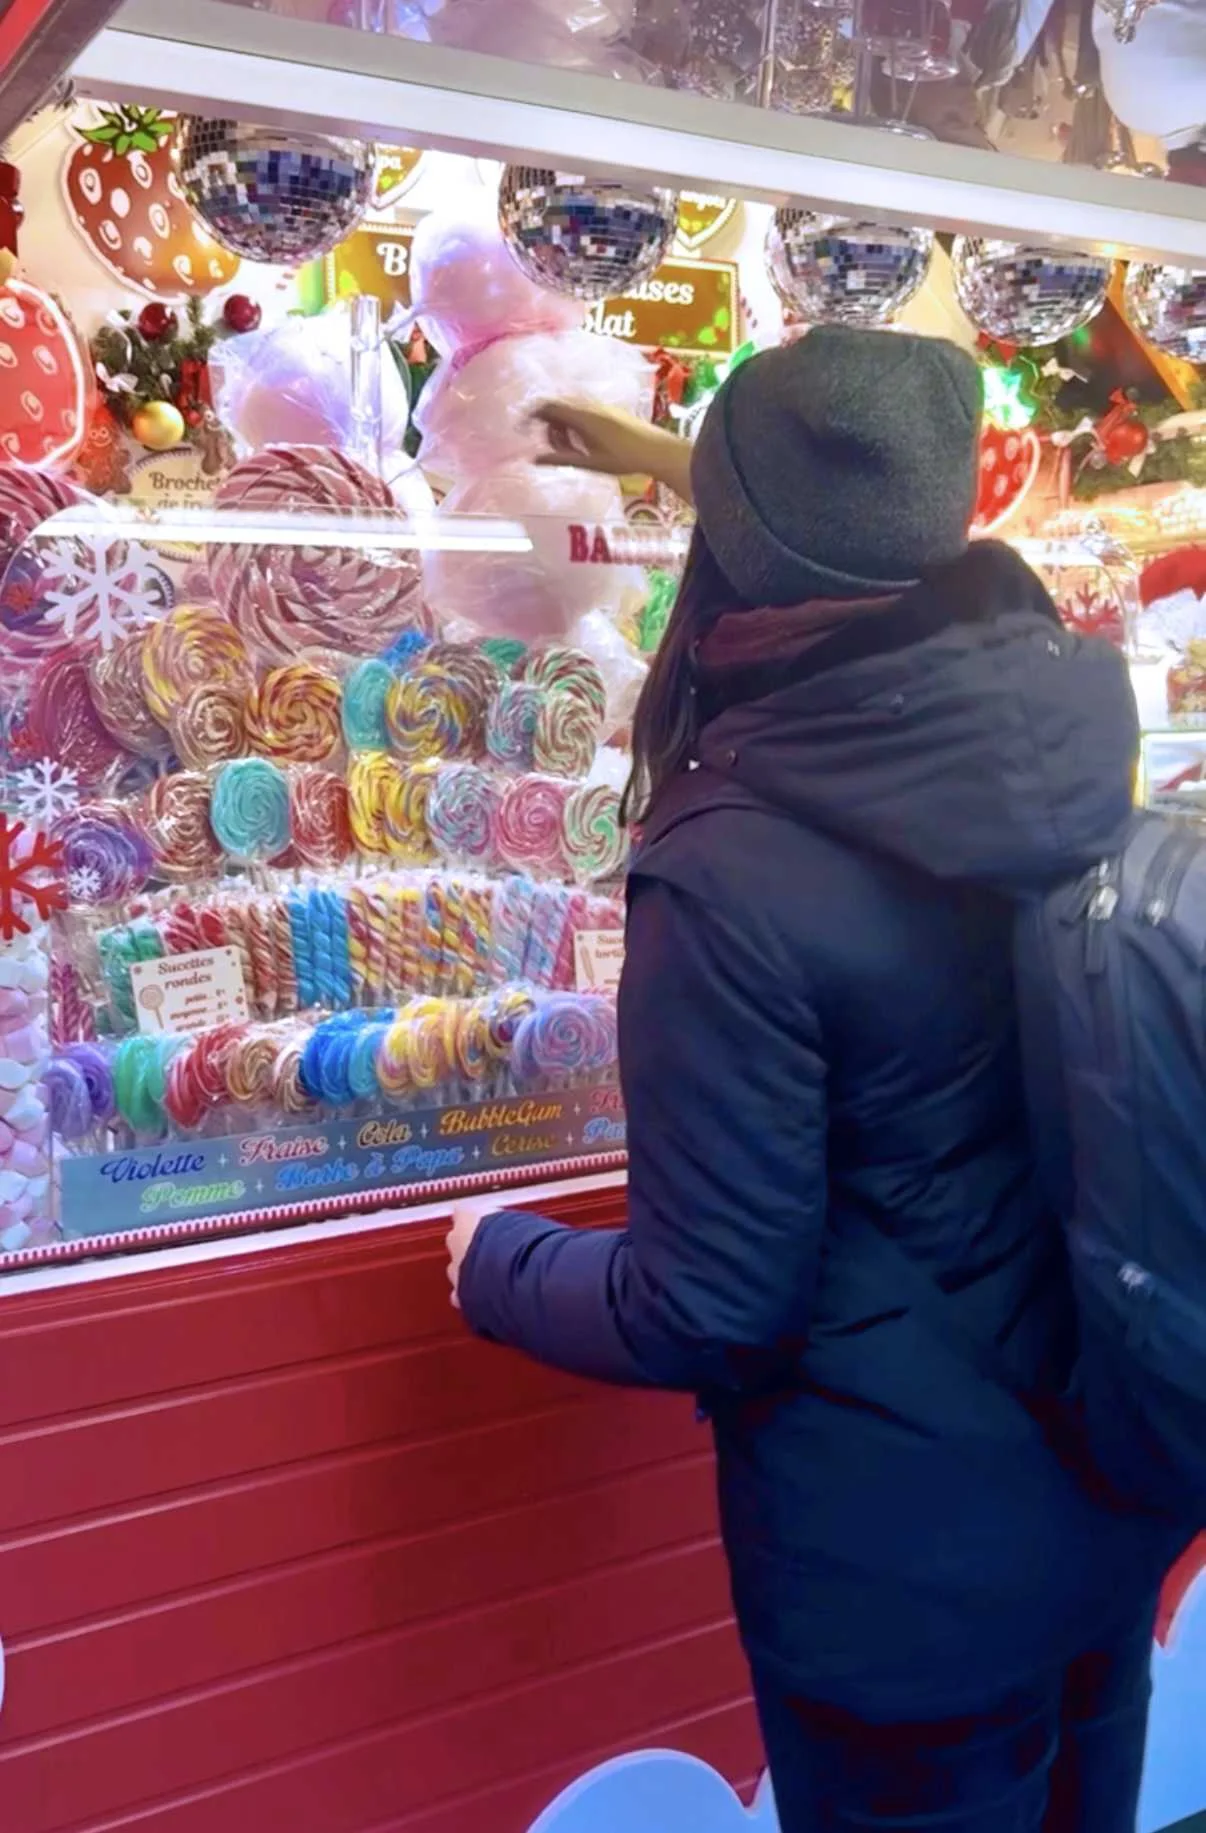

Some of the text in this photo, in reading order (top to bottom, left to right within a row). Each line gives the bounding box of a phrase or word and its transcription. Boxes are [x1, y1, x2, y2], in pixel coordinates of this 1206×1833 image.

[376, 242, 408, 276] B
[148, 472, 220, 491] Broche
[158, 957, 215, 976] Sucettes
[164, 972, 213, 989] rondes
[100, 1088, 622, 1184] Violette Fraise Cola BubbleGum Fr
[139, 1179, 247, 1213] Pomme
[275, 1158, 360, 1191] Barbe
